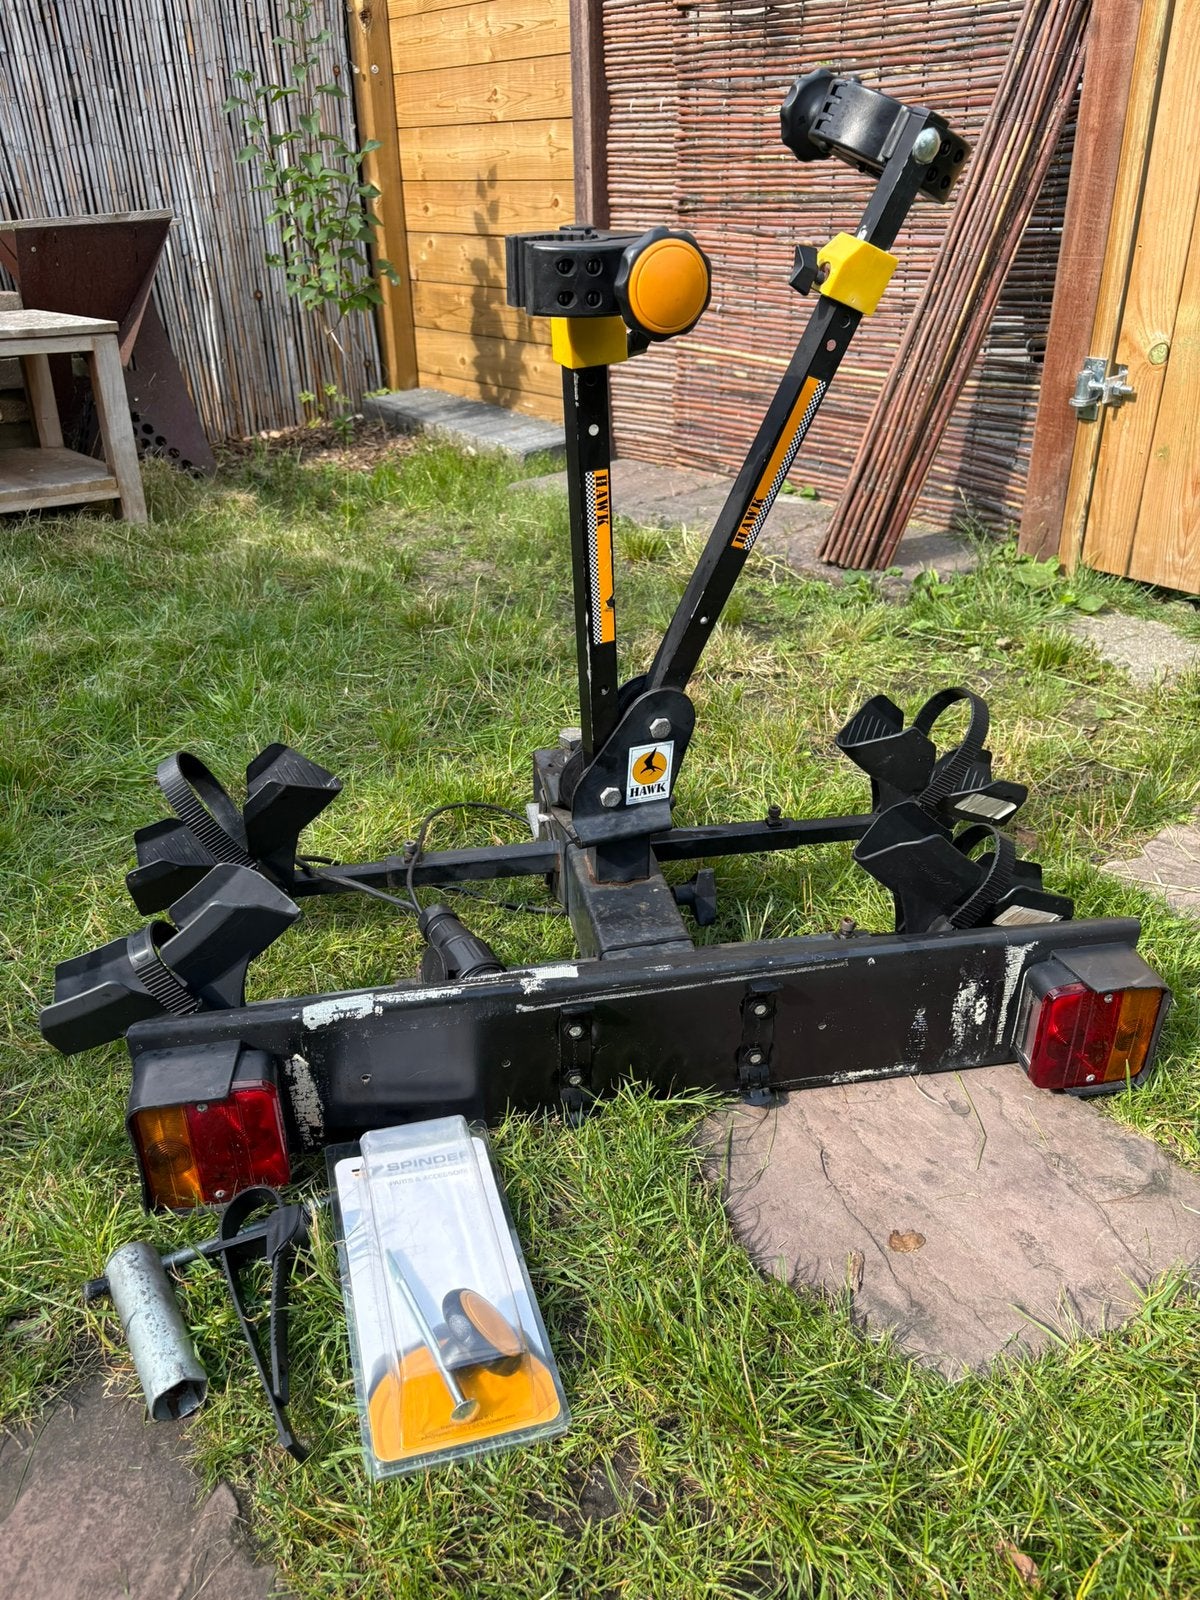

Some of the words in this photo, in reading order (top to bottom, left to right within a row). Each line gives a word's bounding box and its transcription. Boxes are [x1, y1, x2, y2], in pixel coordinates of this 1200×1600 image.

[595, 474, 609, 527] HAWK
[735, 497, 764, 544] HAWK
[630, 782, 666, 798] HAWK
